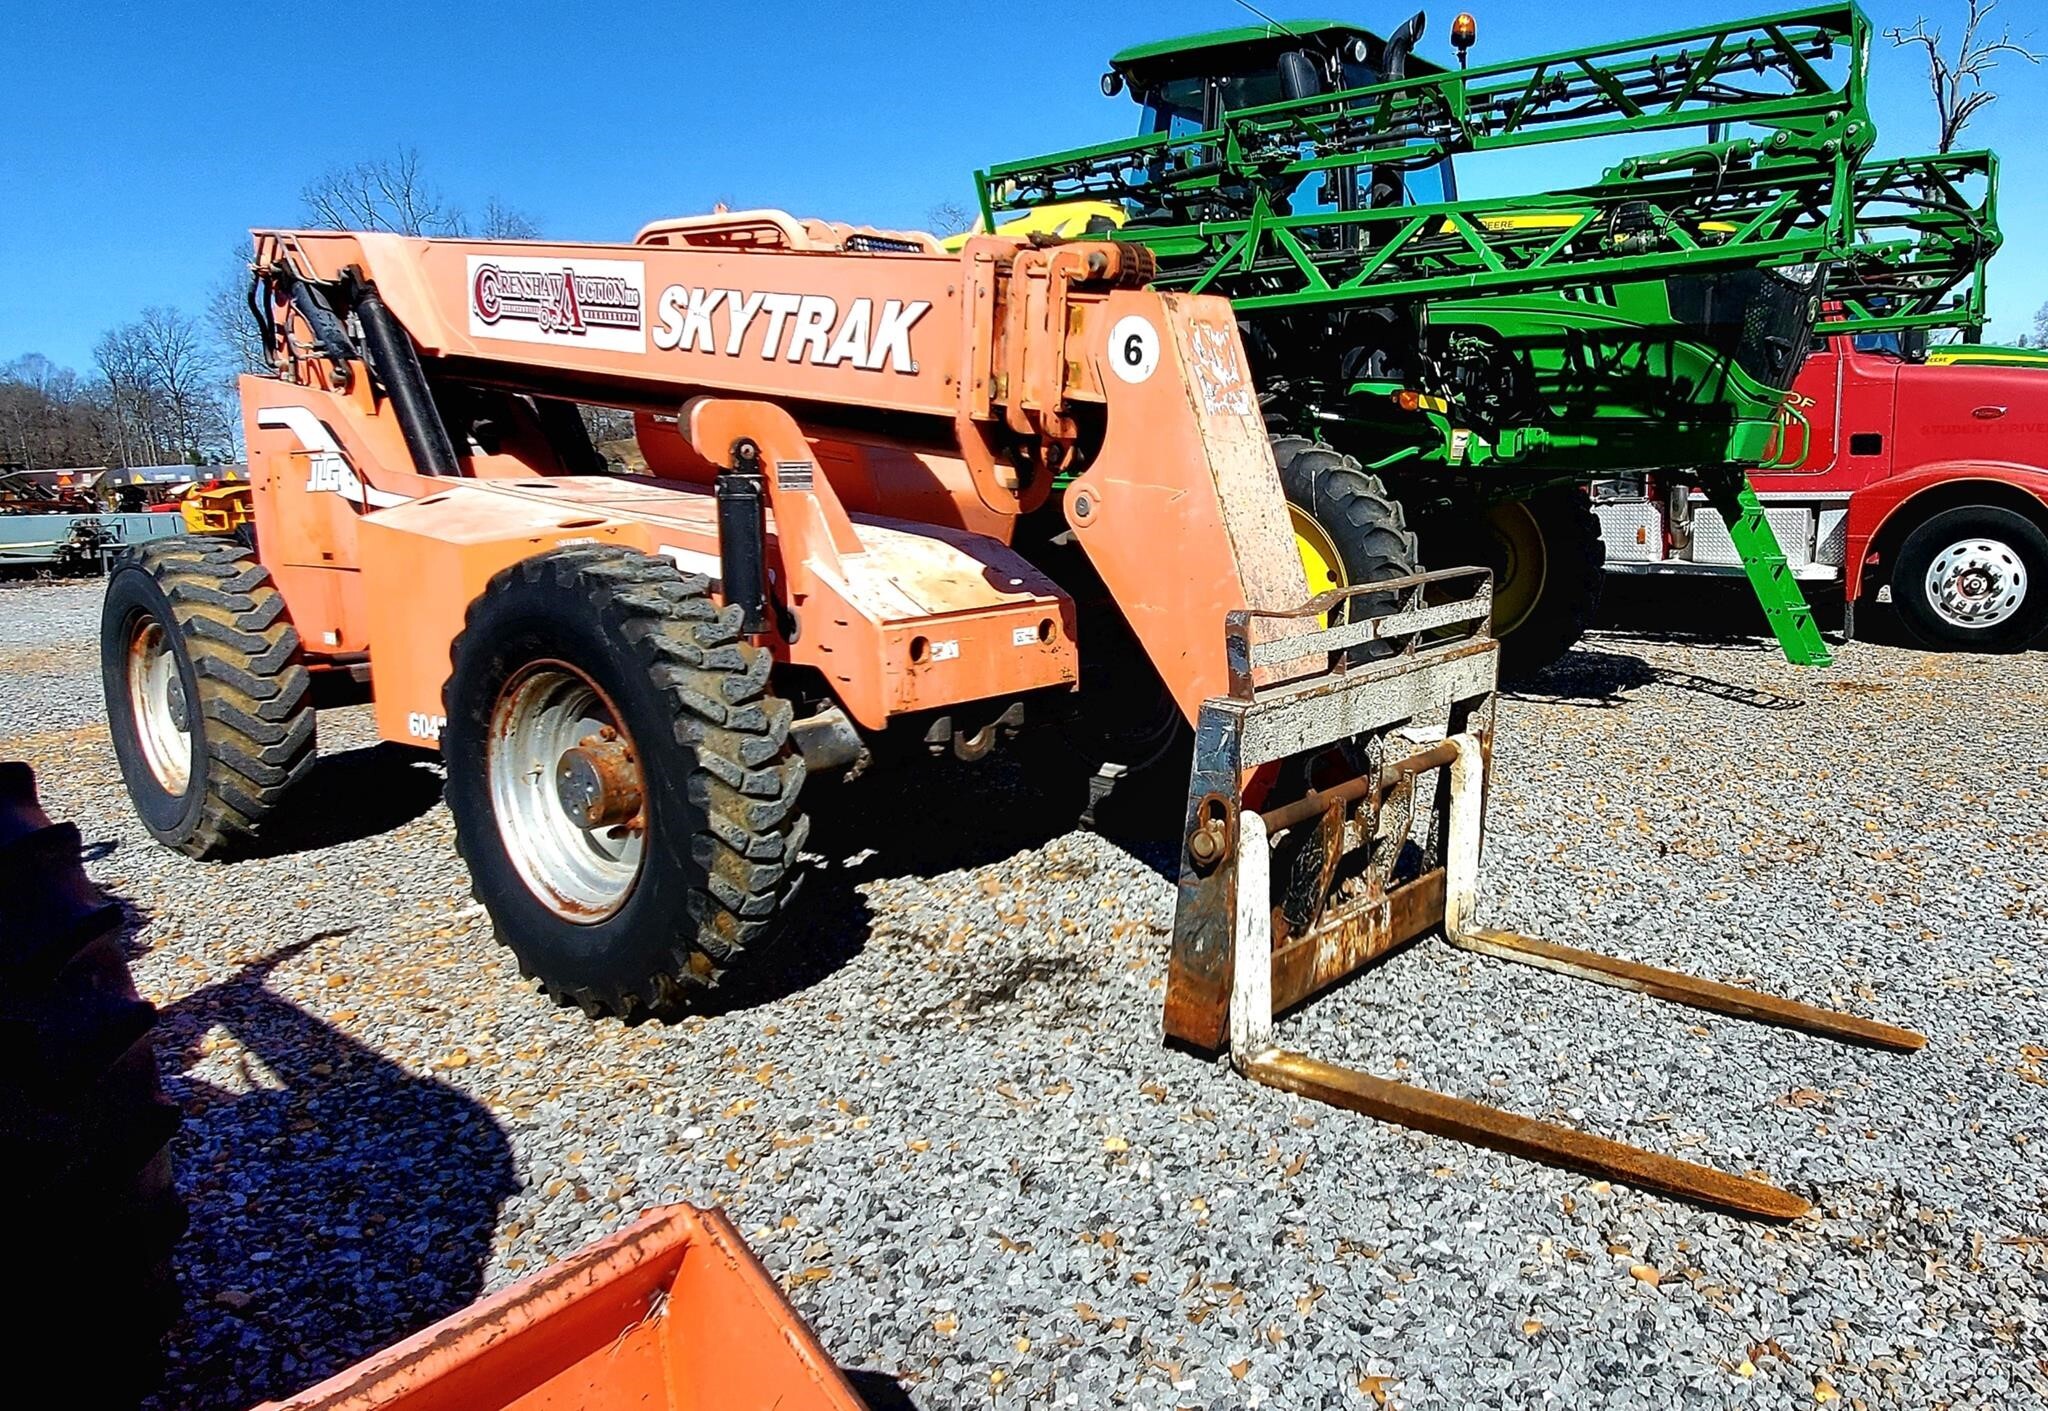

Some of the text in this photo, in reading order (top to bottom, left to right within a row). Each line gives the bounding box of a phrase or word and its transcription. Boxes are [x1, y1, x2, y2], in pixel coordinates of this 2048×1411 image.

[474, 265, 563, 321] CRENSHAW
[557, 268, 627, 335] AUCTION
[651, 284, 932, 376] SKYTRAK
[1124, 333, 1143, 366] 6
[1998, 422, 2048, 435] DRIVE
[305, 457, 341, 493] JLG
